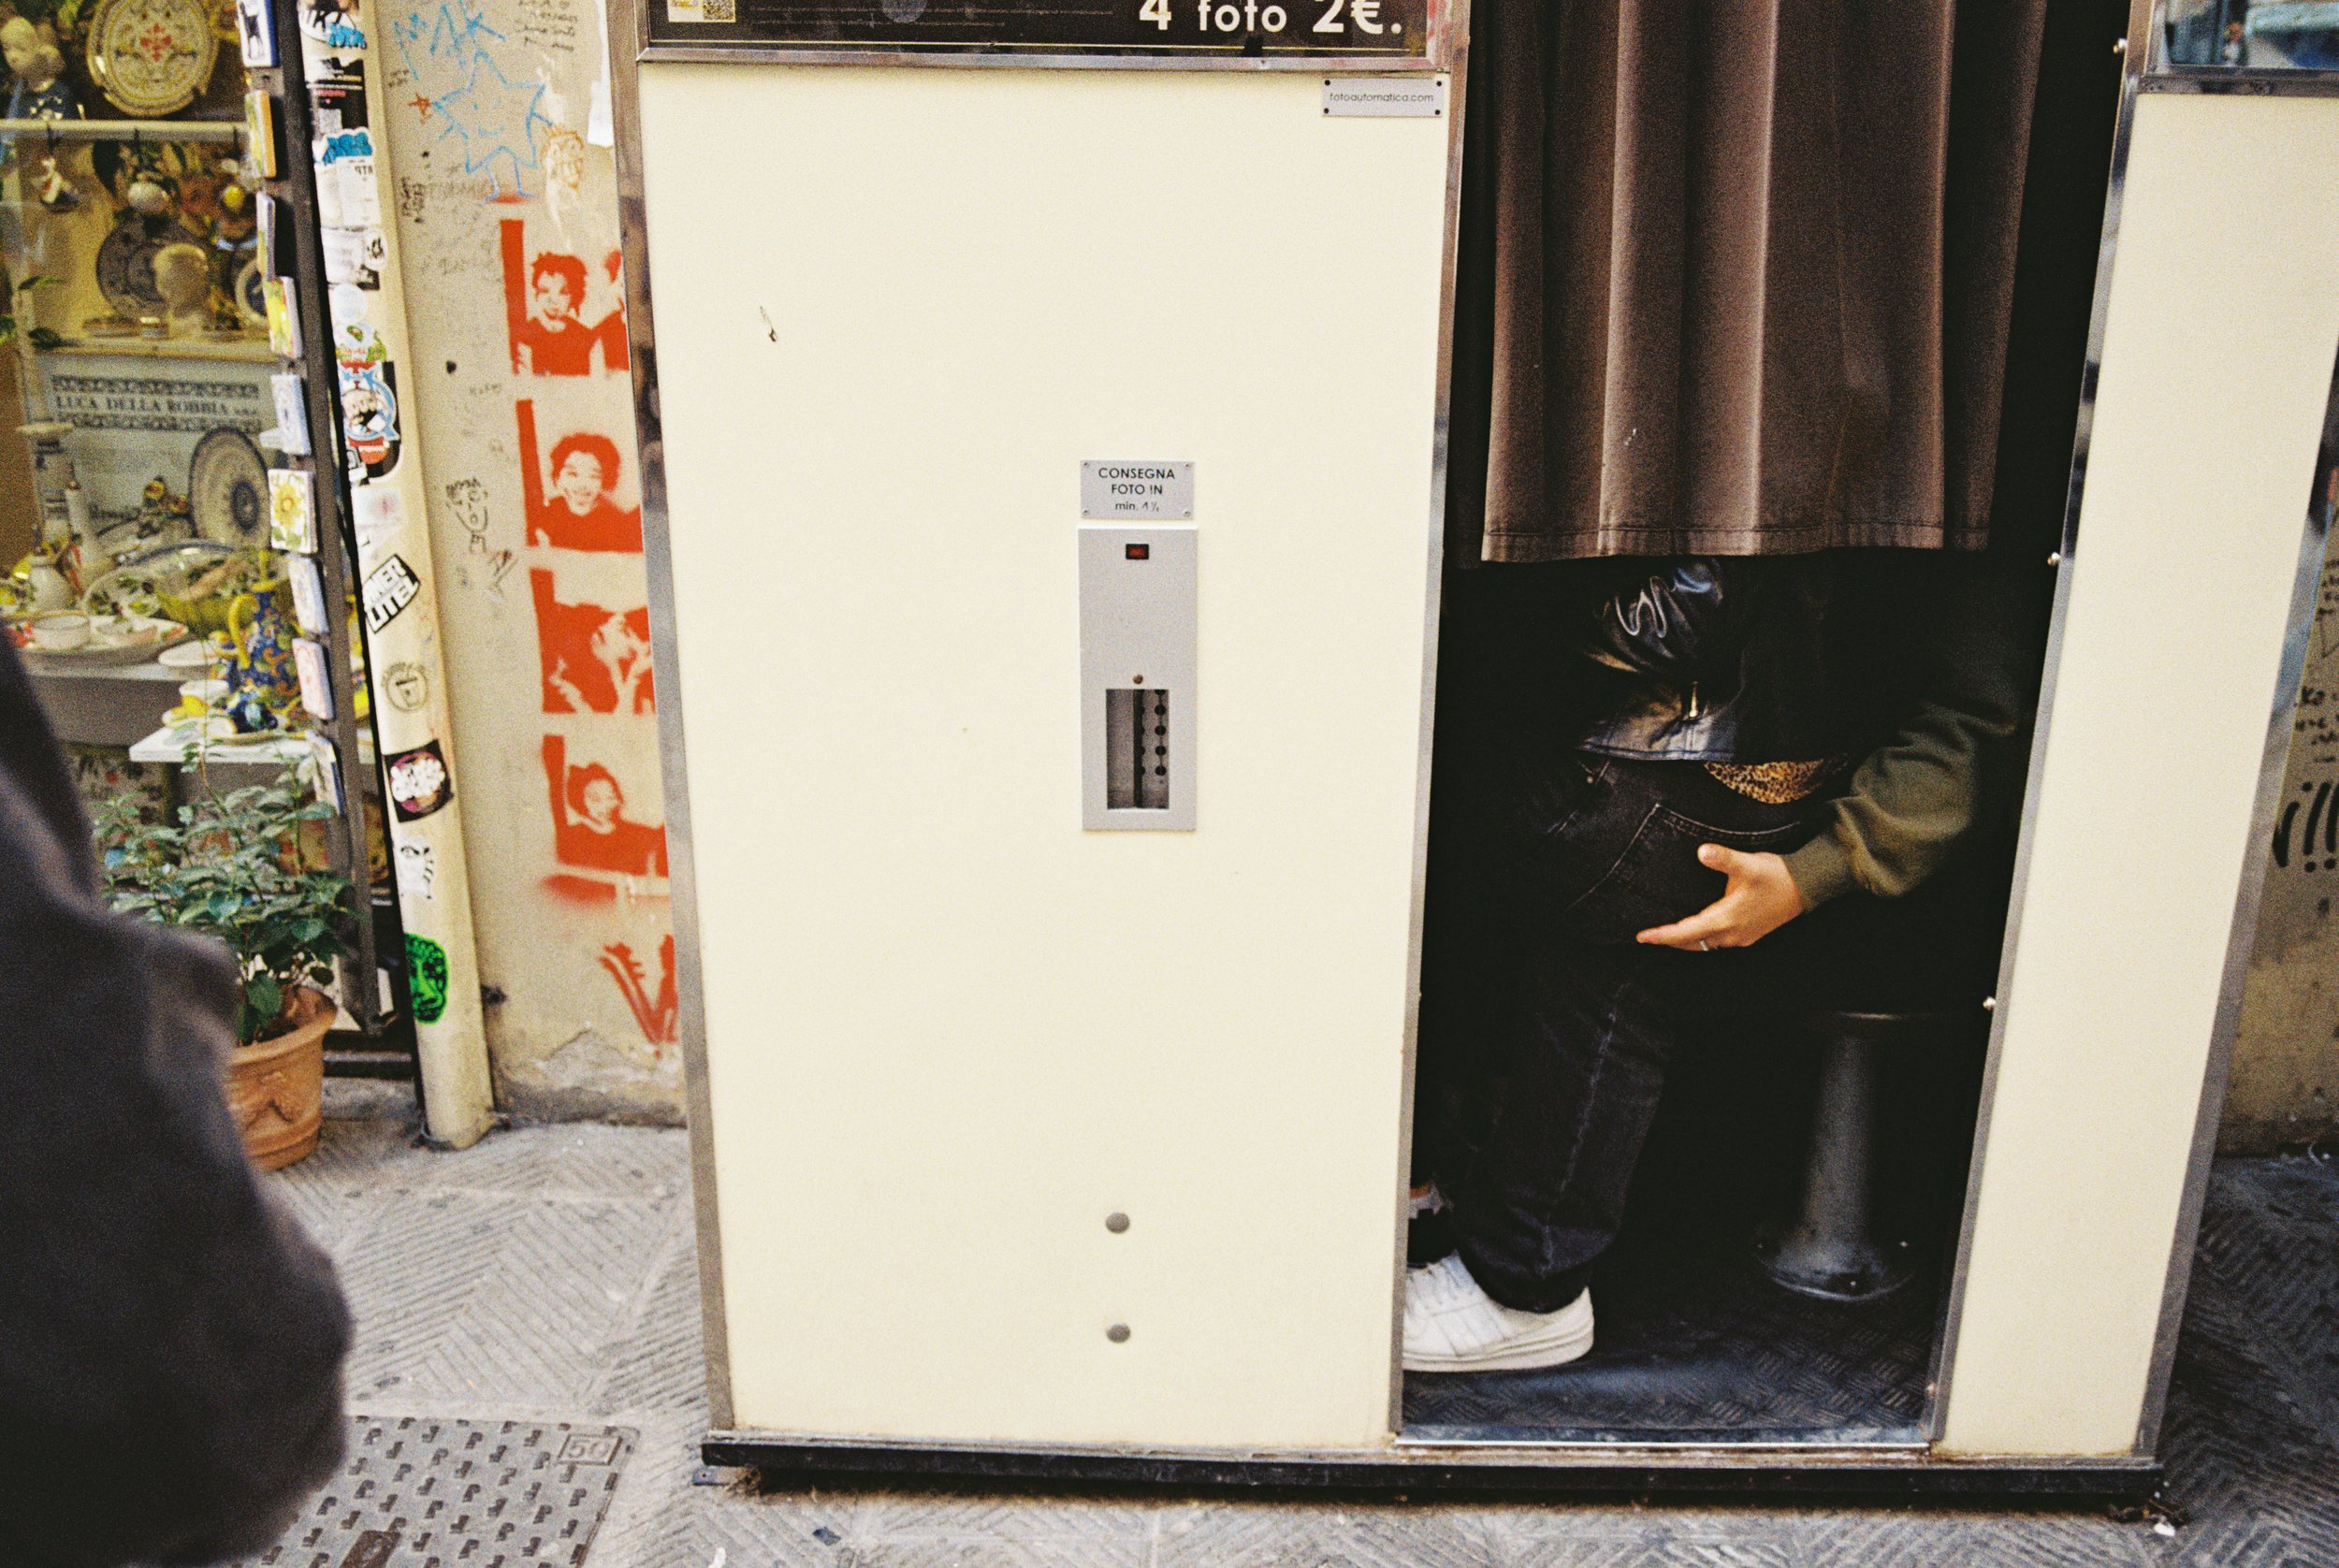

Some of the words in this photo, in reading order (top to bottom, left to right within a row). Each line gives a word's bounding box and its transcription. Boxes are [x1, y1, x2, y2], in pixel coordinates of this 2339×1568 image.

[1139, 0, 1172, 31] 4
[1198, 0, 1287, 33] foto
[1329, 92, 1434, 103] fotoautomatica.com
[56, 396, 100, 410] LUCA
[107, 398, 161, 413] DELLA
[167, 399, 228, 414] ROBBIA
[1098, 467, 1175, 479] CONSEGNA
[1111, 484, 1145, 495] FOTO
[1150, 484, 1163, 495] IN
[1115, 501, 1140, 512] min.
